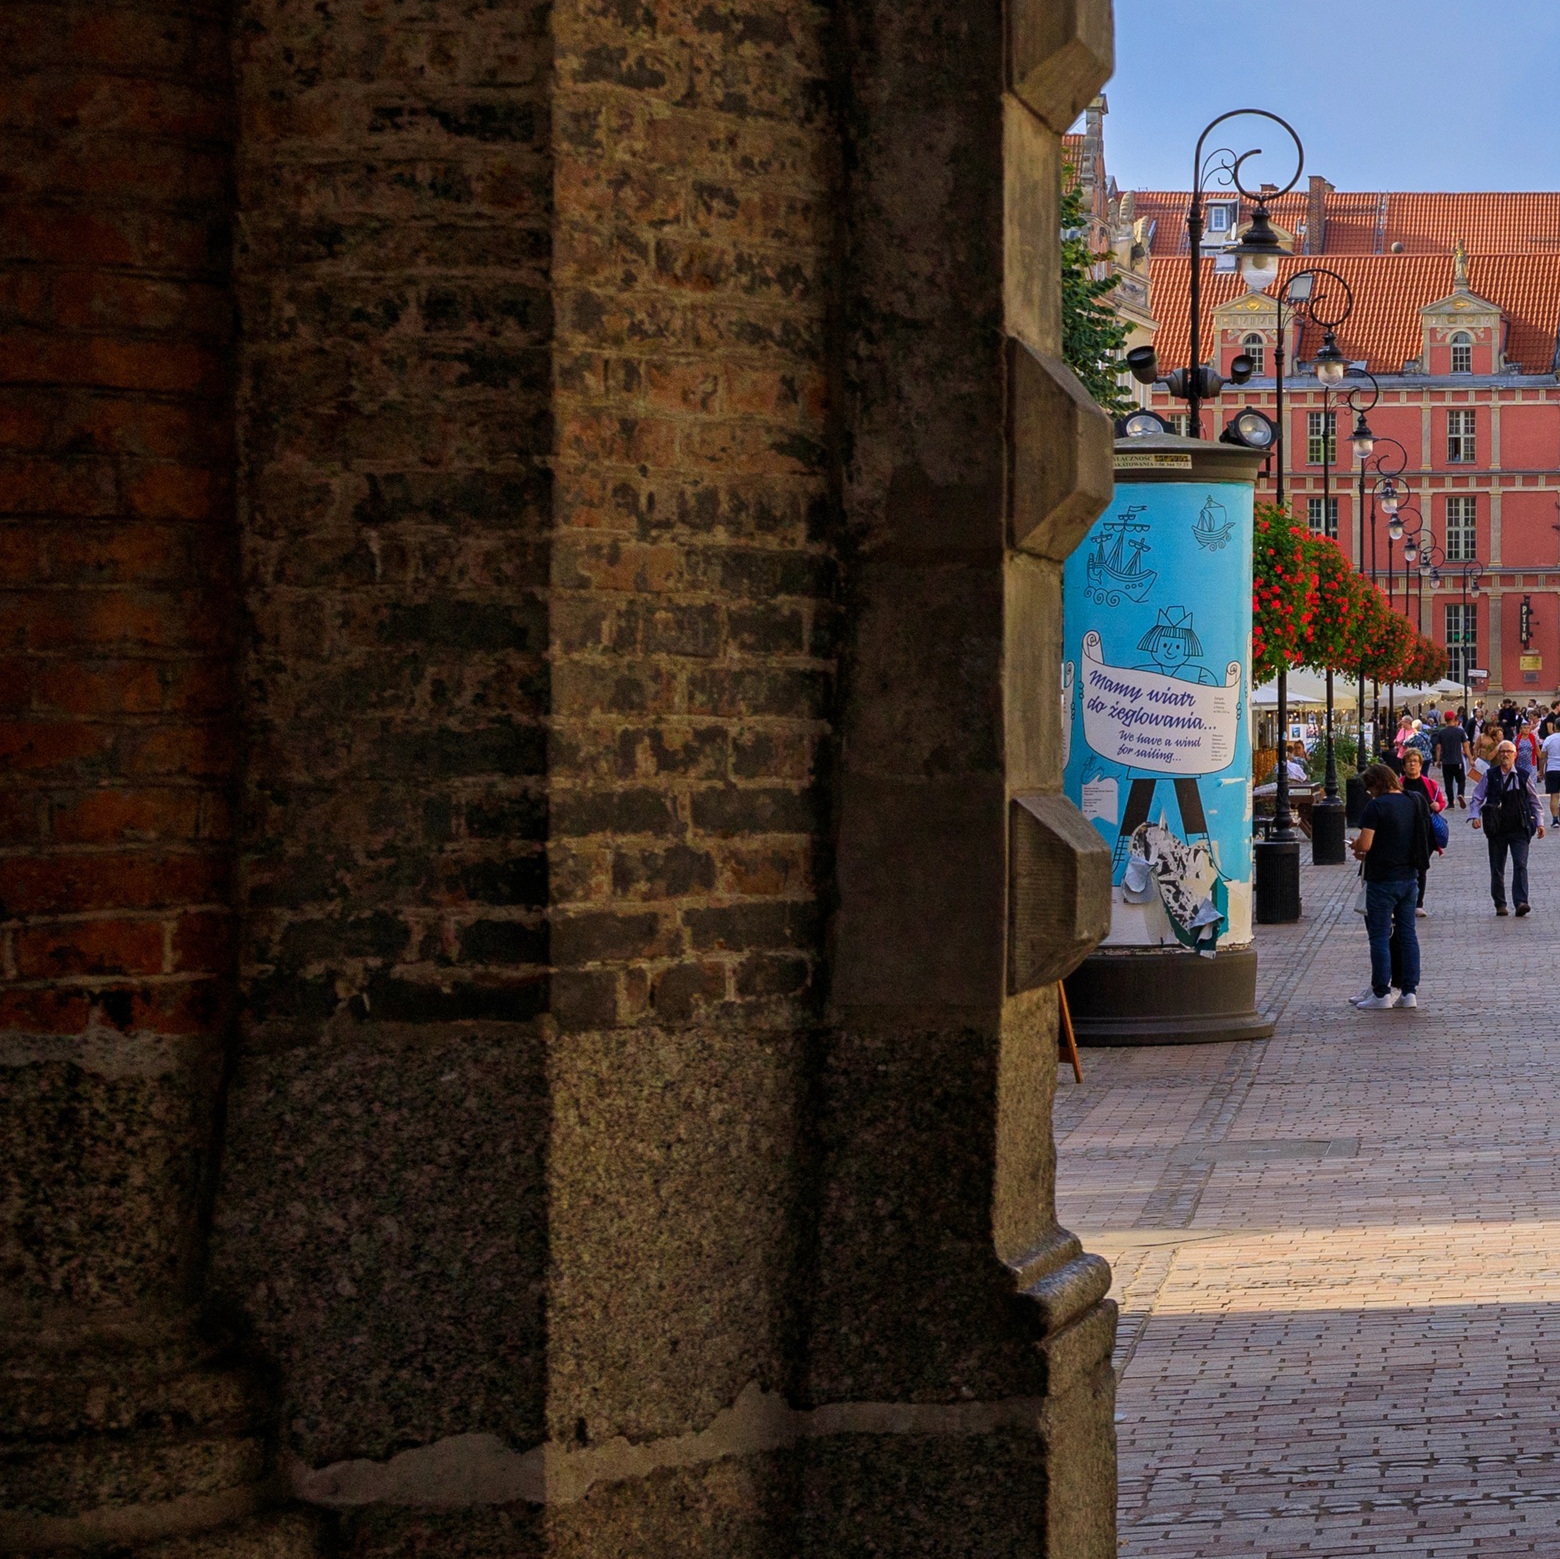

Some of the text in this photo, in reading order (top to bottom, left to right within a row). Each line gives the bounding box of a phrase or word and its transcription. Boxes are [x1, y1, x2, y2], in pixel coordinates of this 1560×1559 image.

[1089, 669, 1144, 704] Mamy
[1146, 686, 1197, 708] wiatr
[1086, 695, 1107, 713] do
[1118, 729, 1134, 741] We
[1136, 732, 1163, 747] have
[1164, 736, 1173, 747] a
[1174, 736, 1202, 748] wind
[1116, 743, 1133, 756] for
